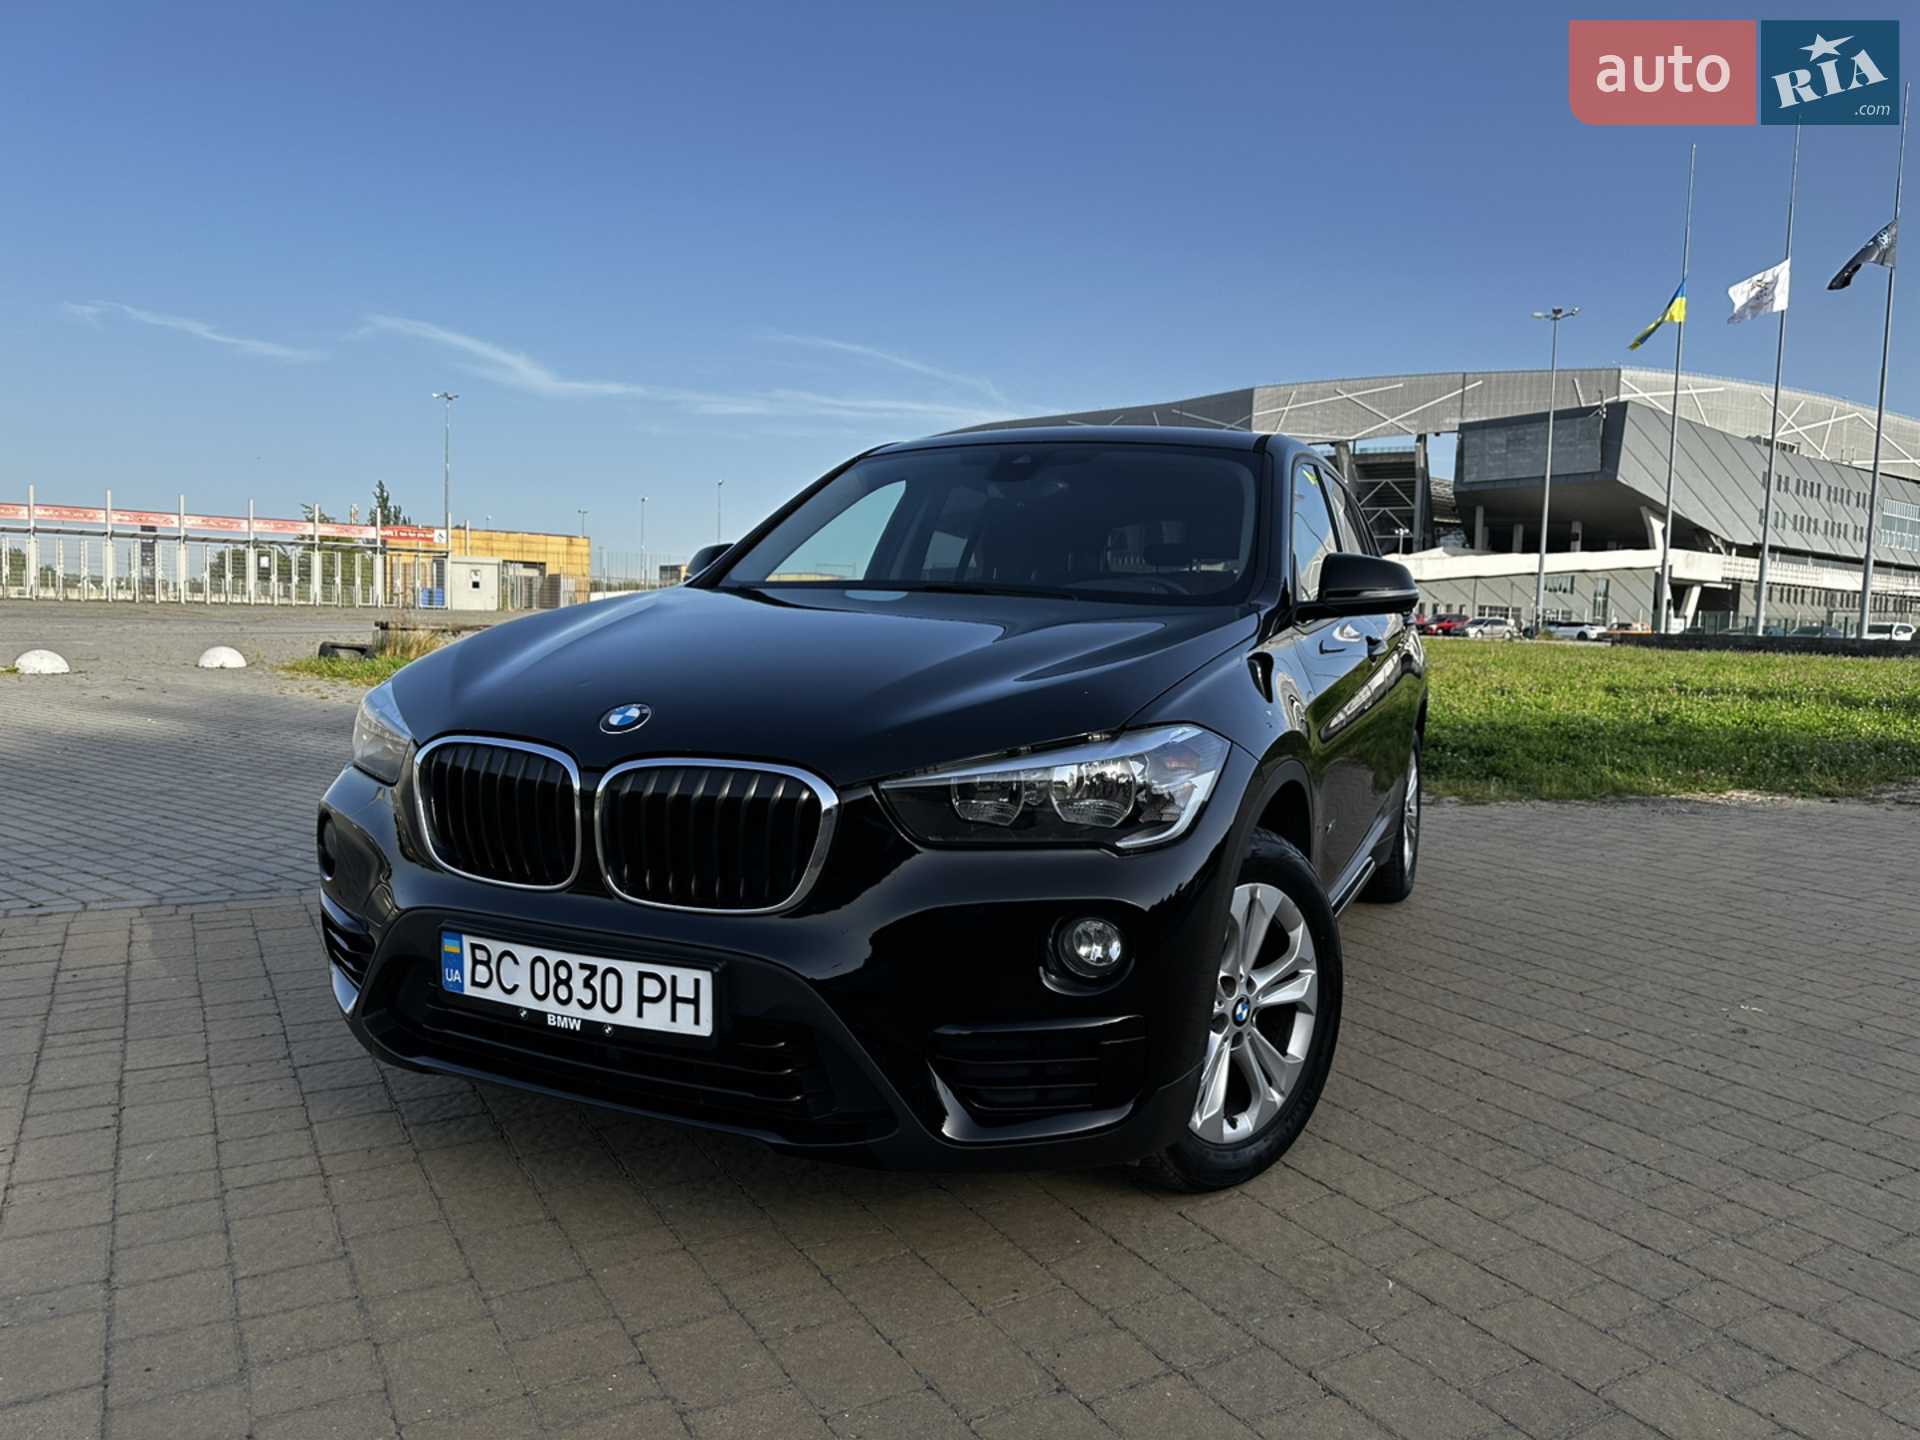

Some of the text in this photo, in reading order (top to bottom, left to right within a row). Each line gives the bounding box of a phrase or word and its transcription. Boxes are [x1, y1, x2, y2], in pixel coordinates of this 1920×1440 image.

[445, 967, 462, 983] UA
[470, 942, 700, 1026] BC 0830 PH
[547, 1013, 582, 1031] BMW
